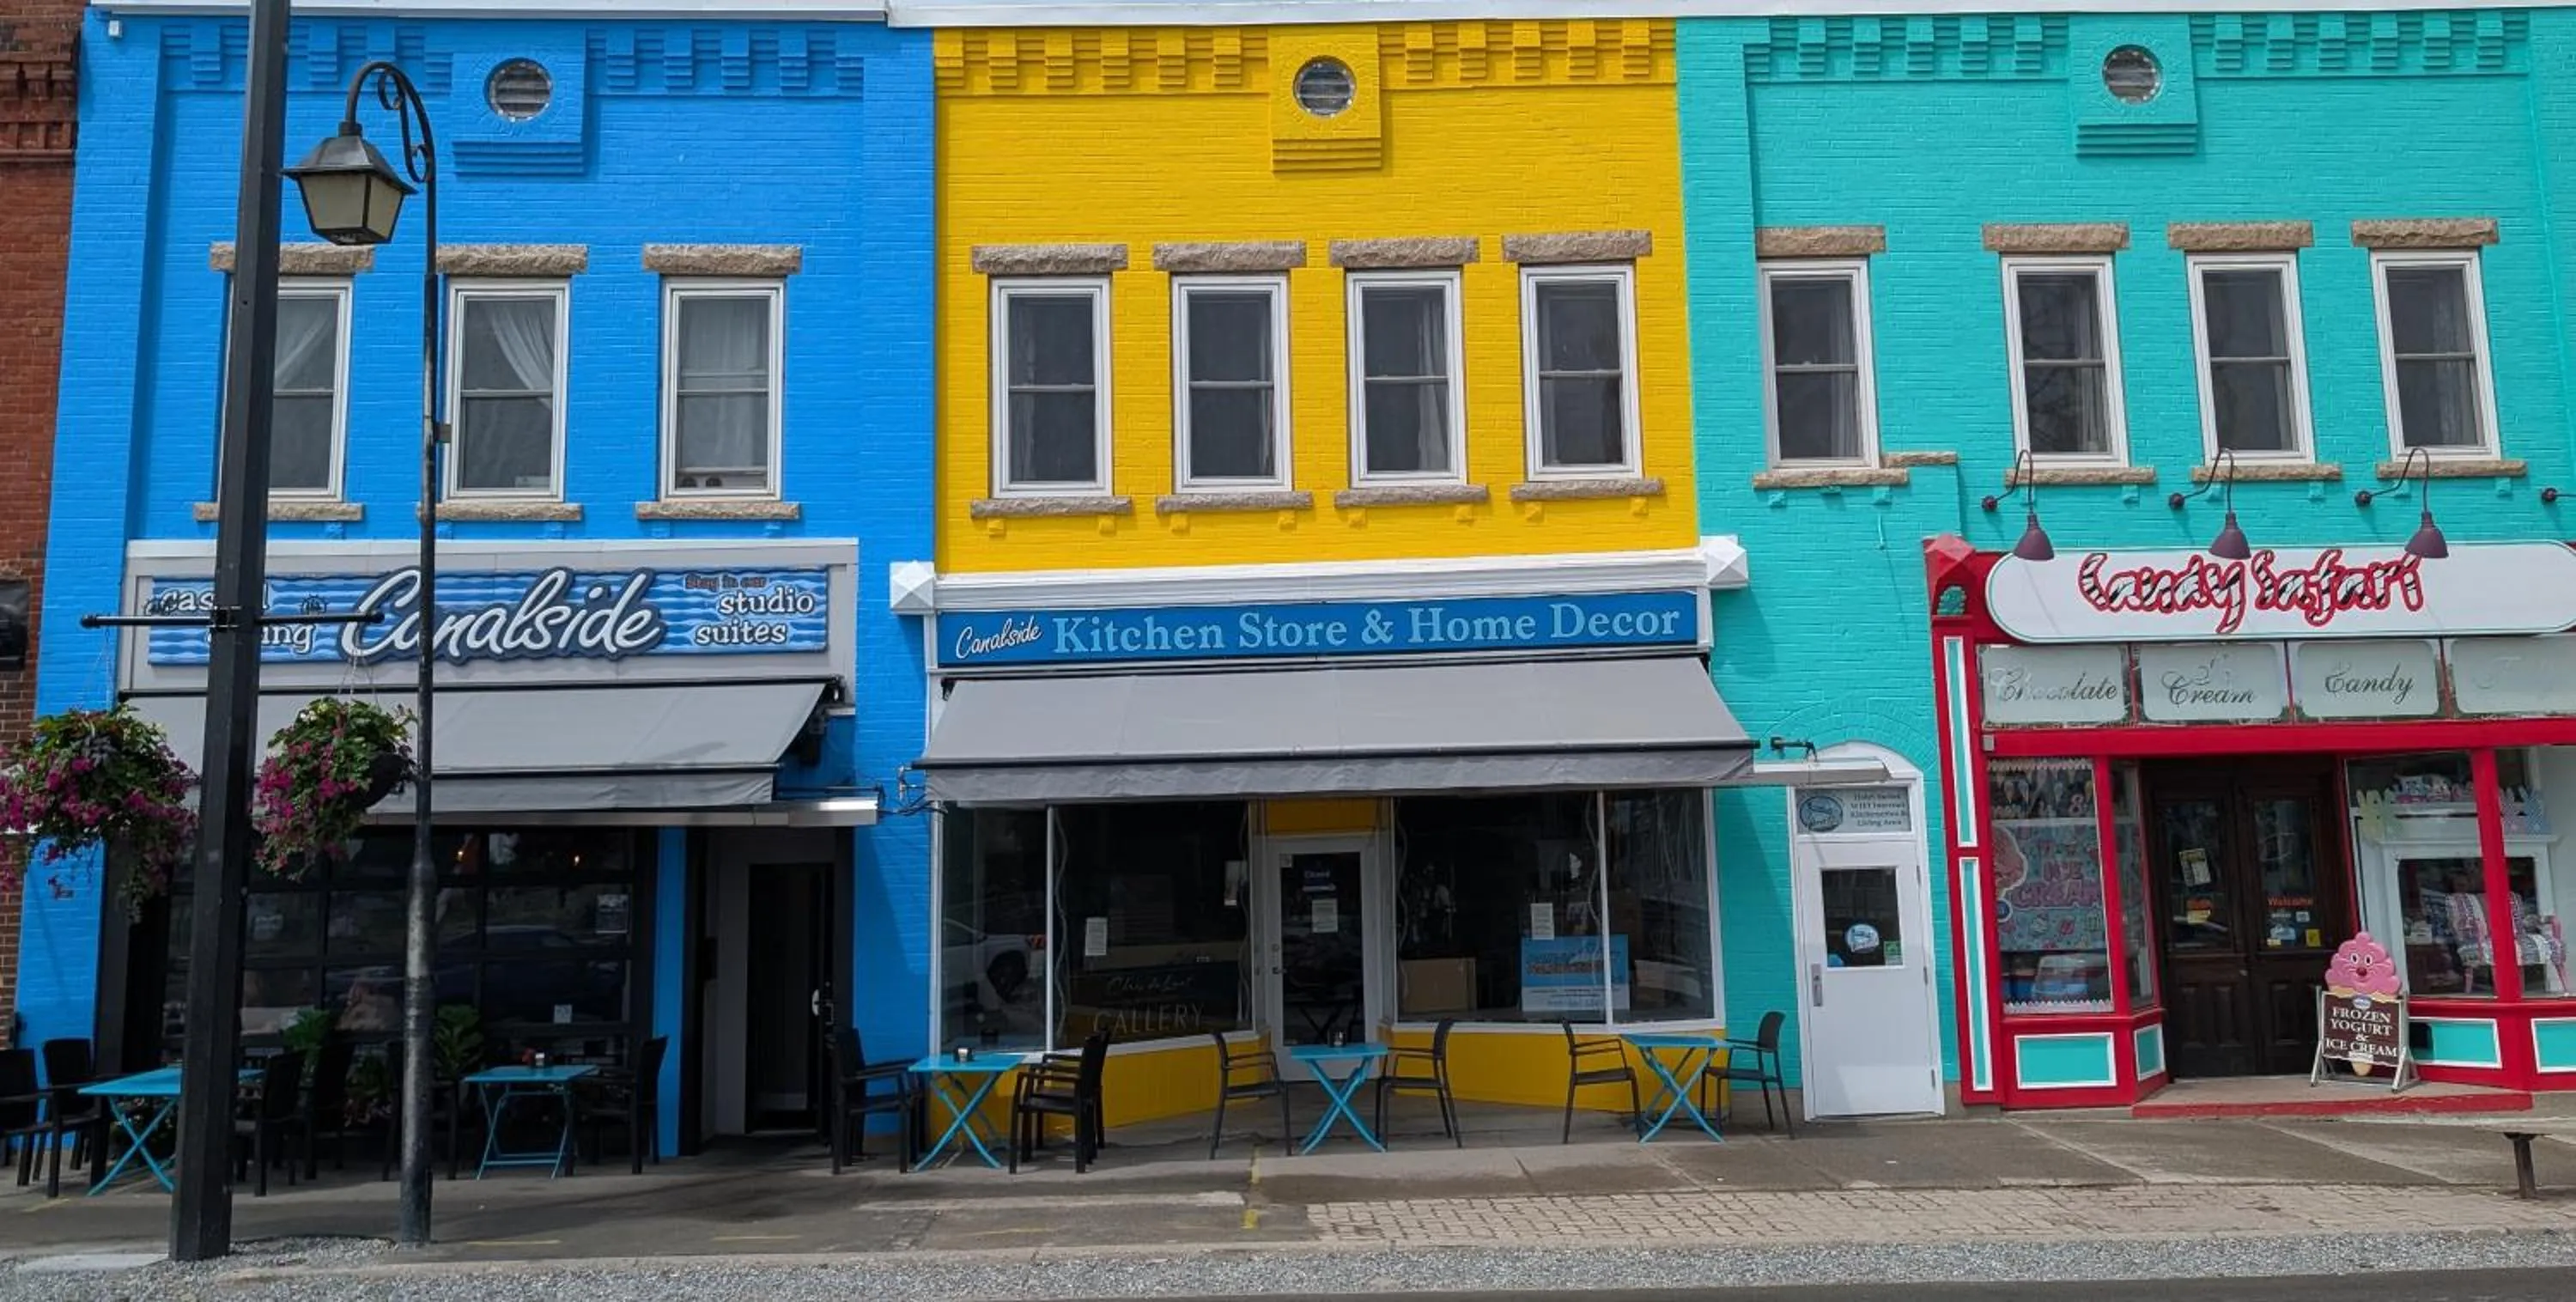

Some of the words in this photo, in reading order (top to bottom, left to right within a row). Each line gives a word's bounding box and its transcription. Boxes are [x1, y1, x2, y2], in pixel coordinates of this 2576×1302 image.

[161, 583, 270, 611] casl
[720, 587, 814, 613] studio
[2079, 553, 2246, 633] Candy
[2251, 549, 2423, 627] Safari
[341, 569, 661, 660] Canalside
[696, 618, 787, 643] suites
[955, 615, 1042, 660] Canalside
[1053, 614, 1225, 654] Kitchen
[1239, 612, 1348, 649] Store
[1361, 609, 1394, 645] &
[1407, 607, 1536, 643] Home
[1549, 603, 1680, 639] Decor
[2161, 671, 2254, 707] Cream
[2325, 660, 2414, 705] Candy
[2330, 1019, 2392, 1036] YOGURT
[2332, 1007, 2391, 1022] FROZEN
[2326, 1037, 2348, 1050] ICE
[2350, 1042, 2397, 1056] CREAM
